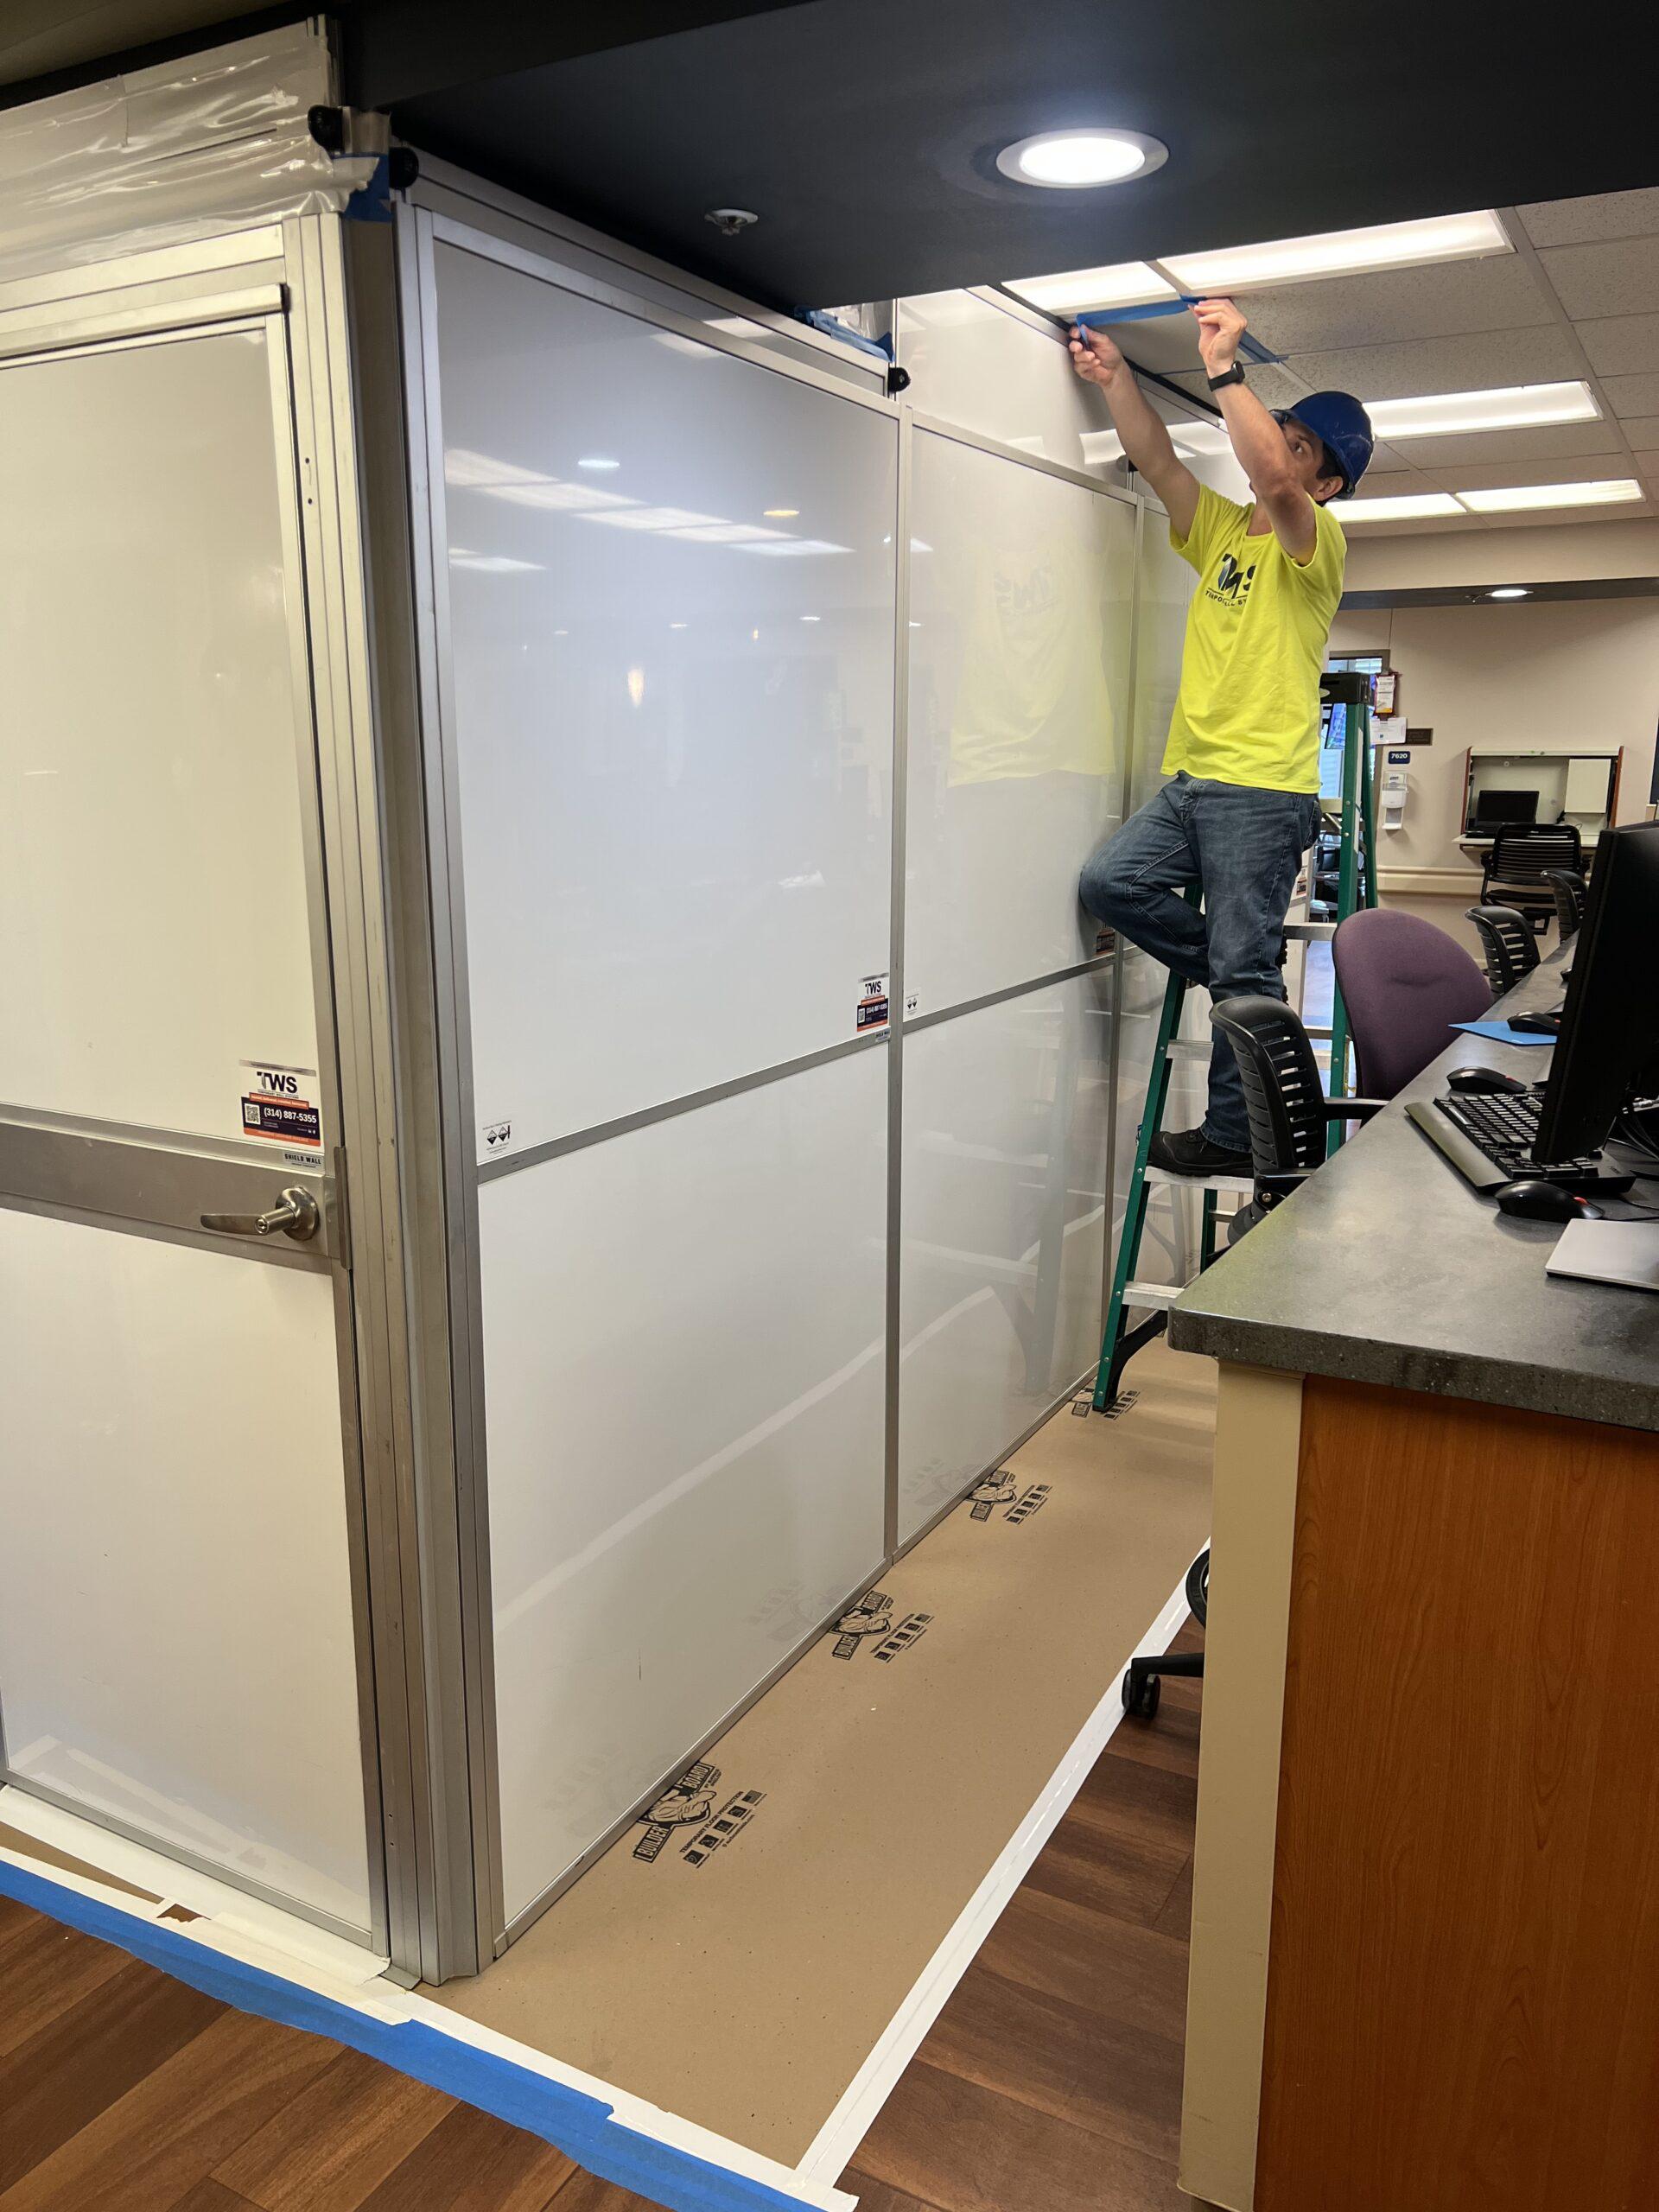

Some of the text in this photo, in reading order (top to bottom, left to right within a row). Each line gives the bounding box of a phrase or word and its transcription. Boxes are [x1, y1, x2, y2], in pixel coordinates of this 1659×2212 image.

[864, 981, 882, 995] TWS
[257, 1071, 297, 1093] TWS
[264, 1107, 317, 1123] (314) 887-5355
[284, 1154, 321, 1165] SHIELD WALL
[682, 1765, 709, 1789] BOARD
[636, 1826, 670, 1855] BUILDER
[679, 1827, 707, 1853] TEMPORARY
